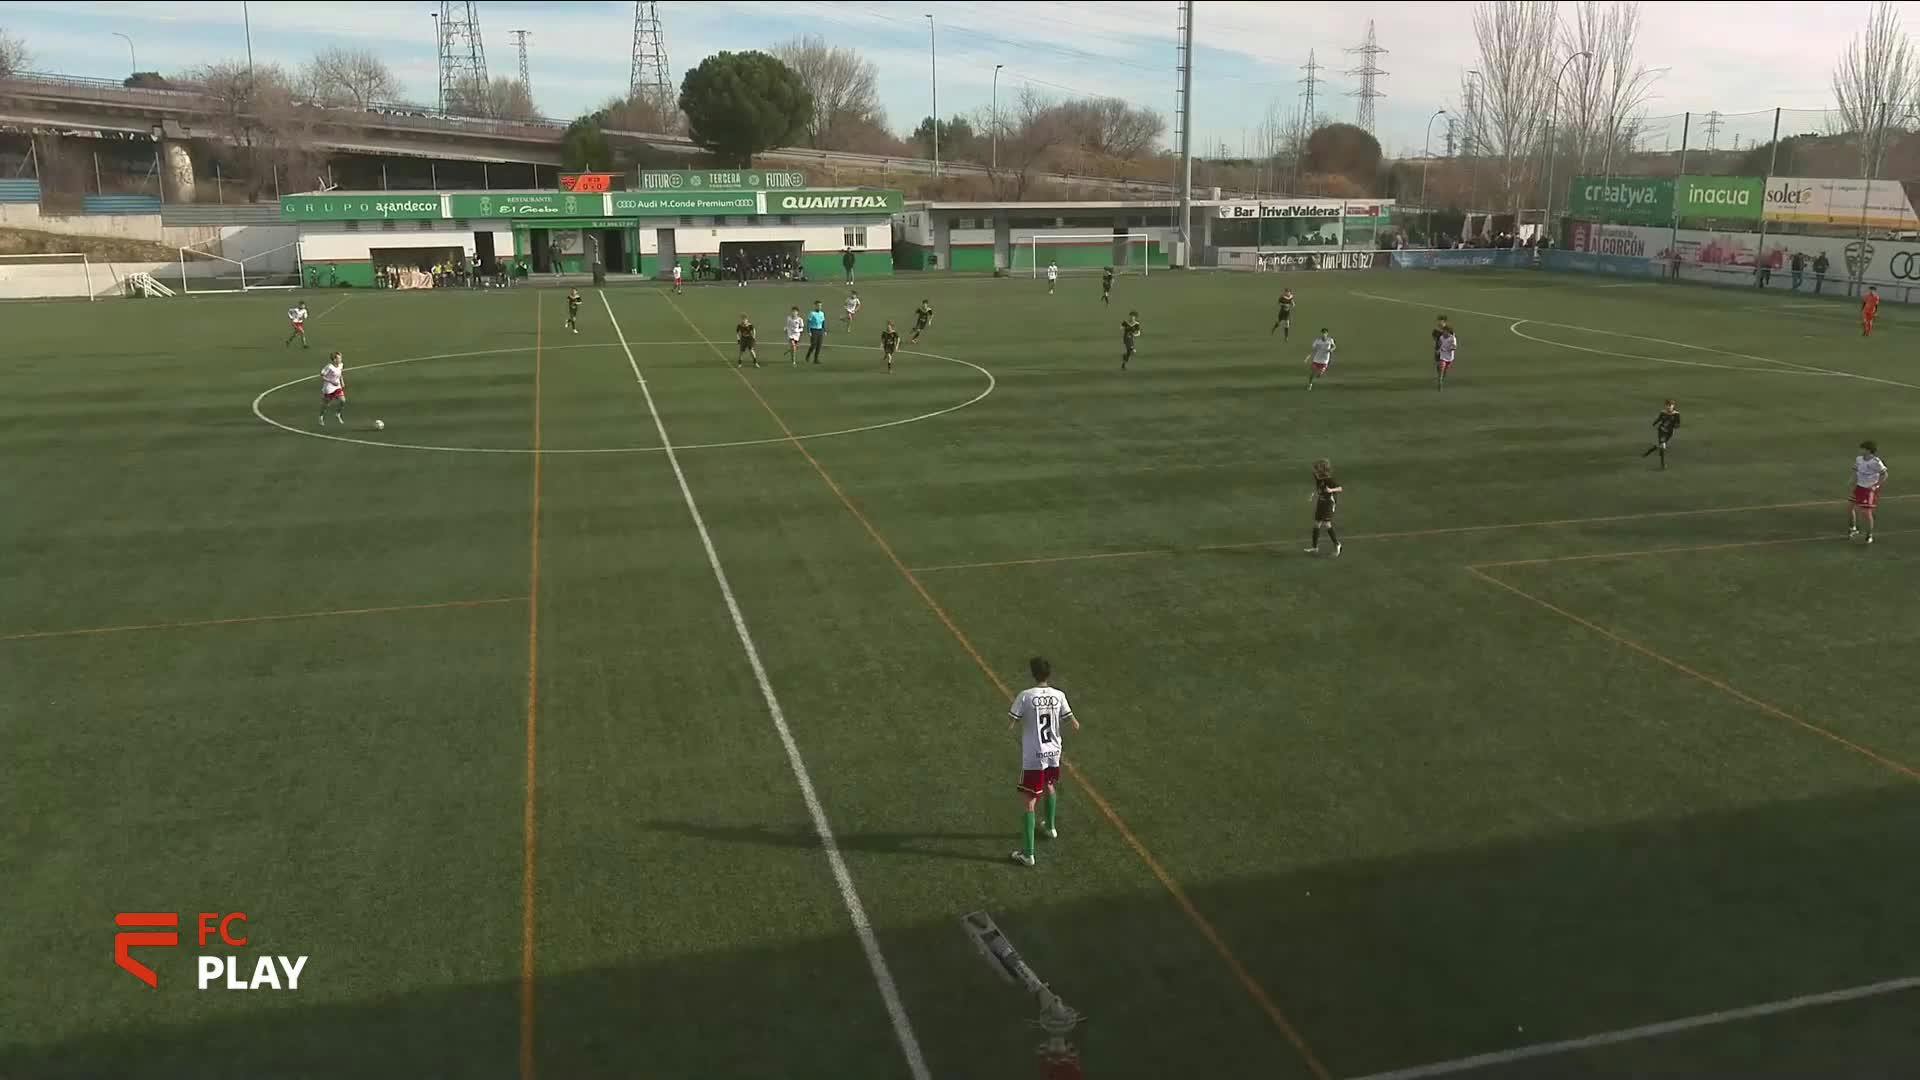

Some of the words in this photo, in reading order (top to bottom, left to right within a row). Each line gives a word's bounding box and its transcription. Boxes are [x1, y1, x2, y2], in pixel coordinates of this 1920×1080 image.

[709, 173, 741, 184] TERCERA
[1688, 183, 1750, 205] inacua
[286, 203, 369, 212] GRUPO
[376, 200, 438, 217] afandecor
[499, 205, 516, 213] El
[637, 199, 658, 208] Audi
[659, 199, 696, 208] M.Conde
[697, 199, 734, 208] Premium
[782, 195, 888, 209] QUAMTRAX
[1234, 206, 1255, 217] Bar
[1261, 205, 1340, 217] TrivalValderas
[1591, 233, 1646, 257] ALCORCÓN
[1039, 713, 1052, 744] 2
